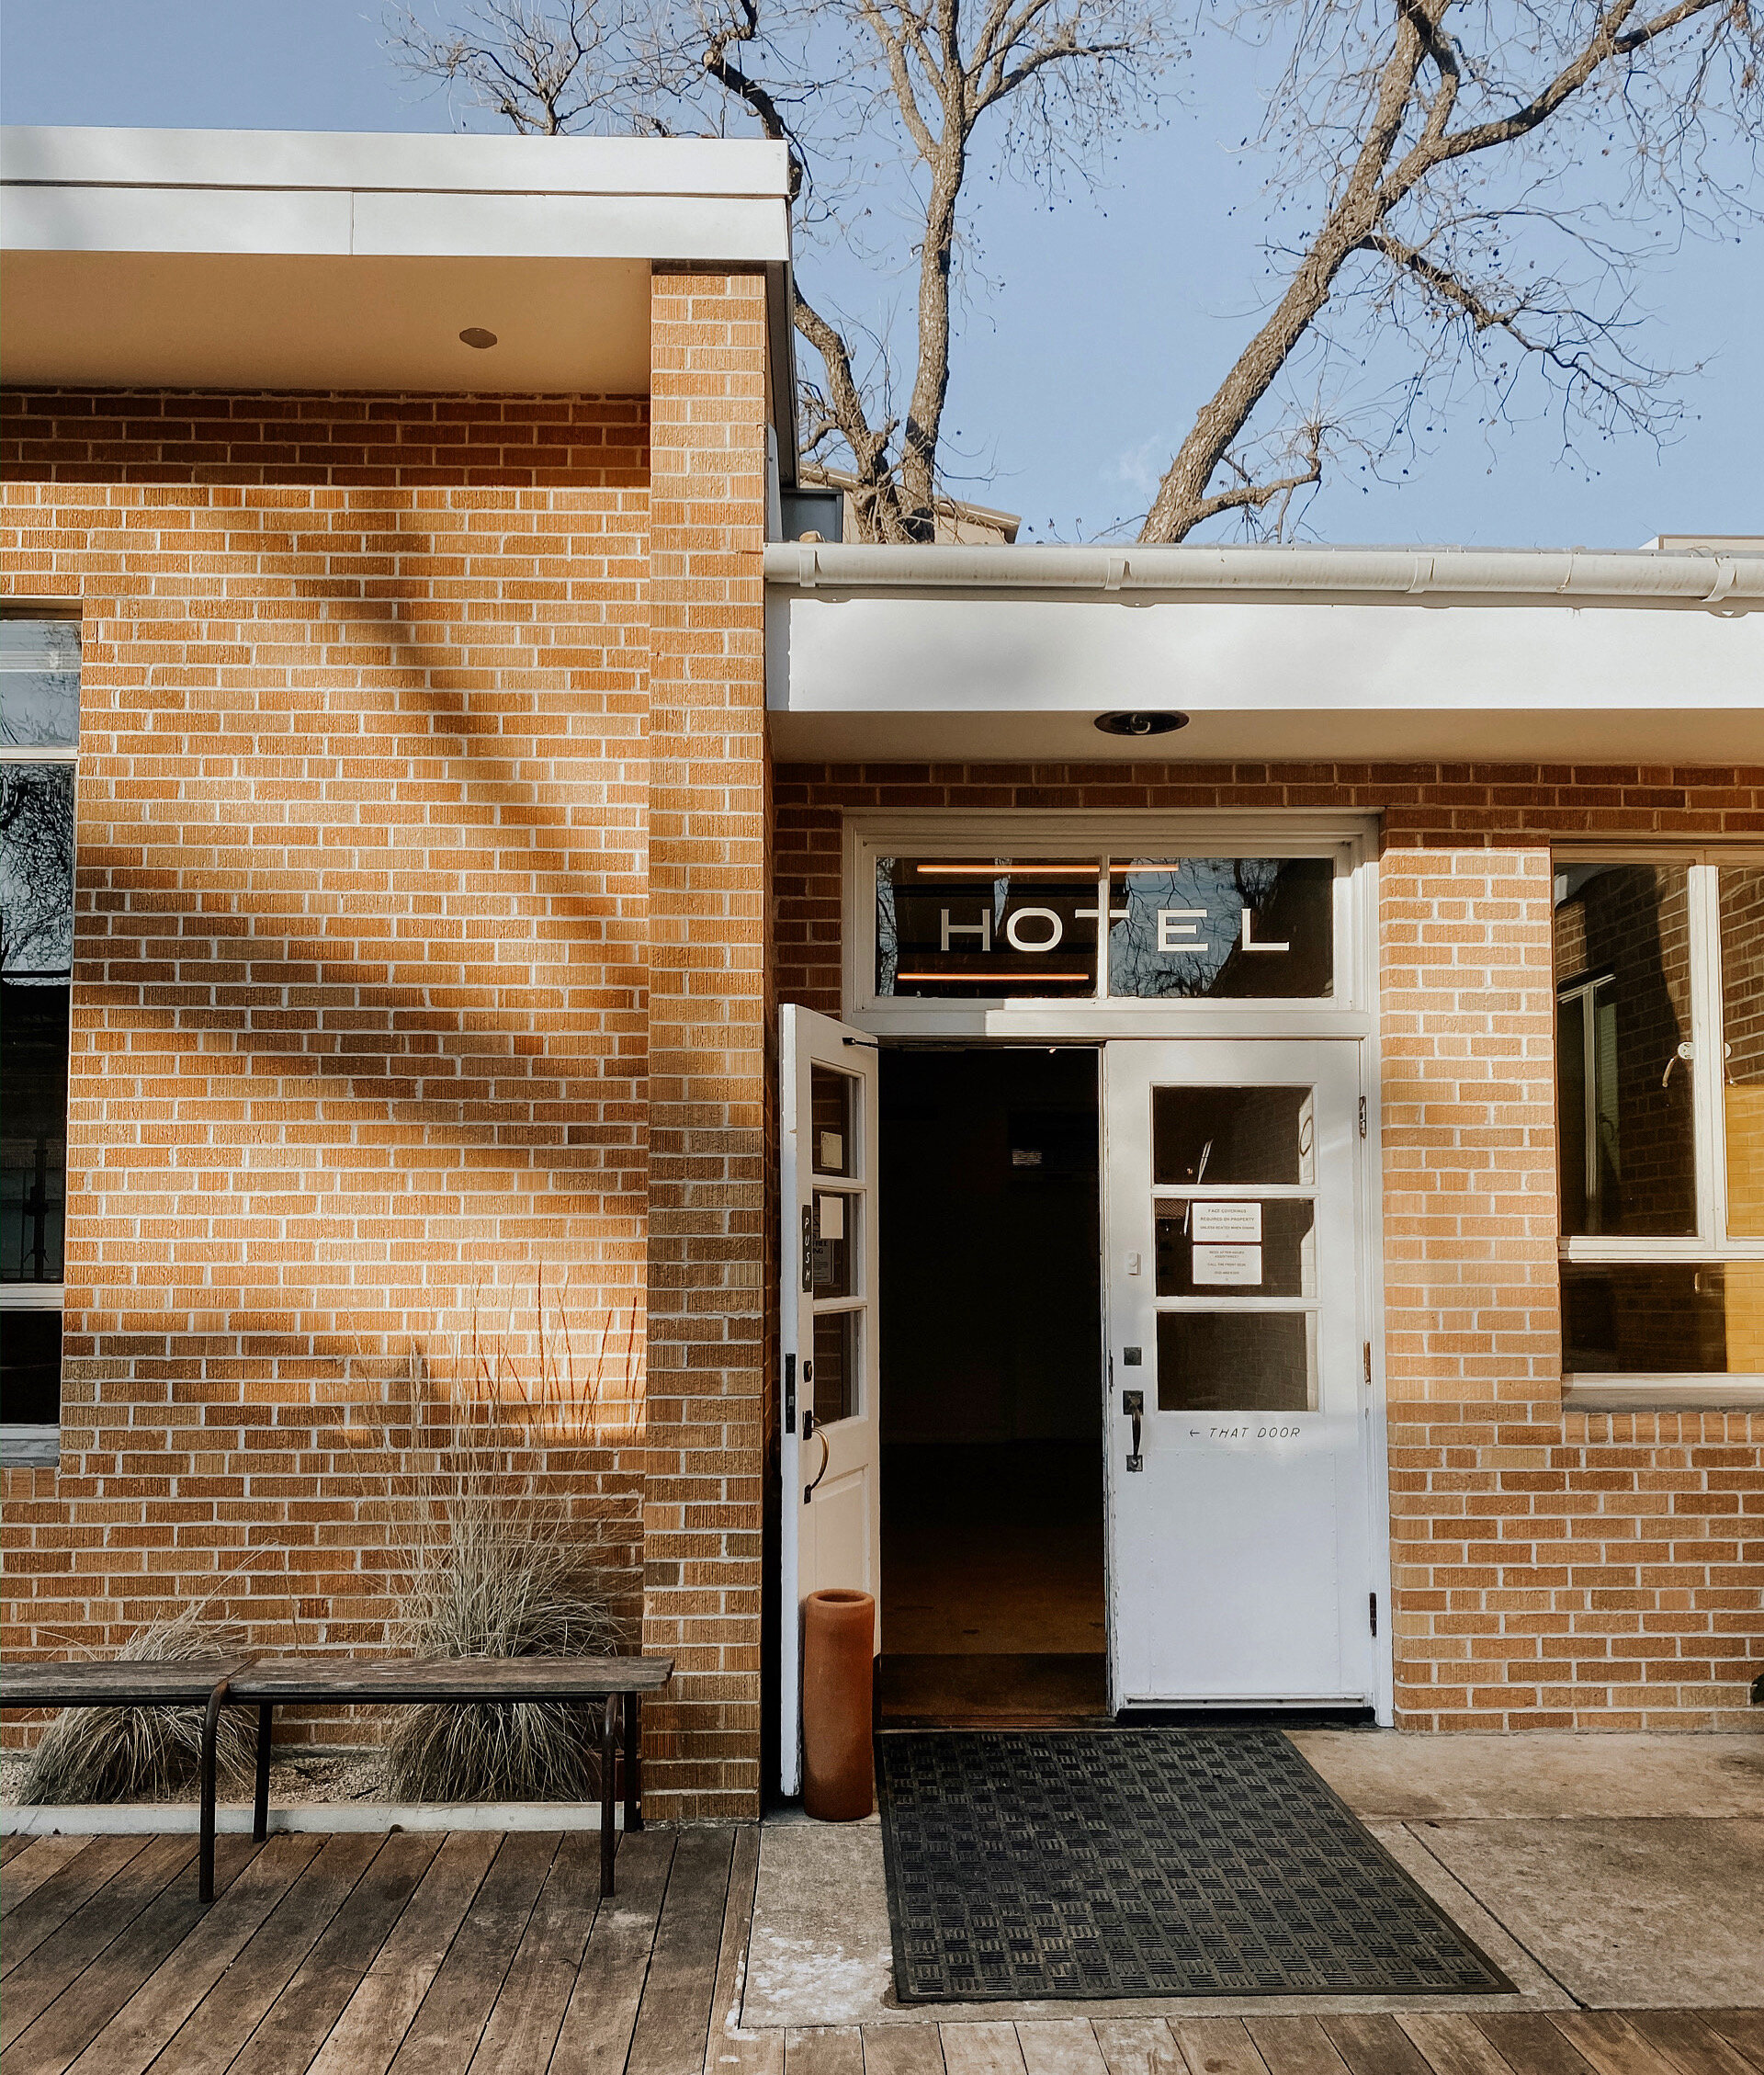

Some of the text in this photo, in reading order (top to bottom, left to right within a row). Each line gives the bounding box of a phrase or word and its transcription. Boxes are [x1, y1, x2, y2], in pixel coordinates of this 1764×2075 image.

[940, 907, 1290, 952] HOTEL
[1209, 1427, 1301, 1438] THAT DOOR
